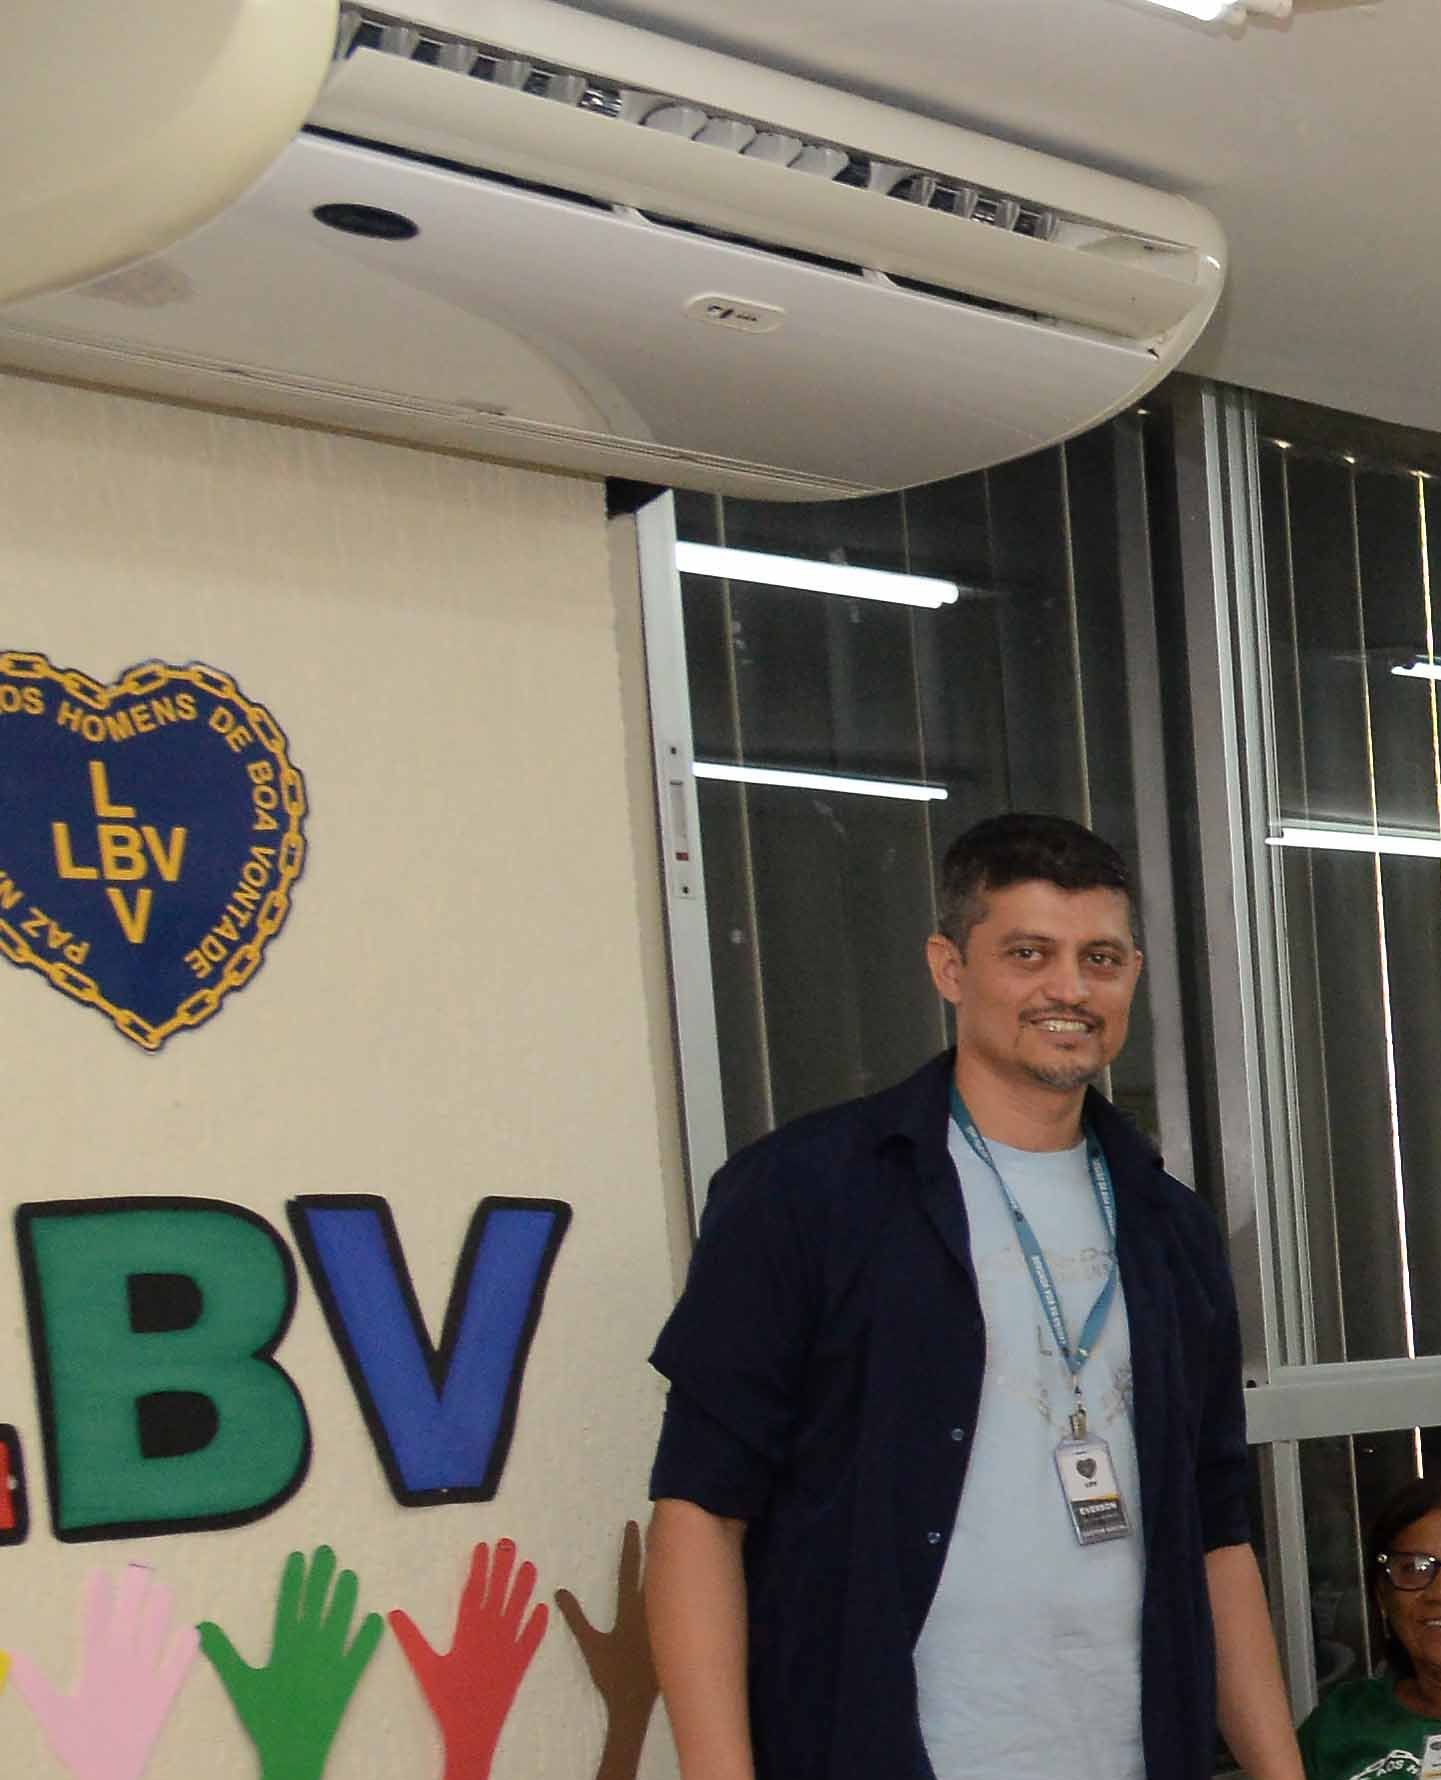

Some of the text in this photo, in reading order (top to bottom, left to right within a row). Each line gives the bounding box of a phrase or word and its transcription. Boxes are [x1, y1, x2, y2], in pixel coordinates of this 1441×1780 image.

[57, 692, 196, 742] HOMENS
[209, 706, 252, 752] DE
[88, 760, 135, 818] L
[246, 760, 279, 833] BOA
[52, 820, 187, 882] LBV
[21, 907, 91, 965] PAZ
[107, 888, 152, 944] V
[183, 845, 277, 979] VONTADE
[0, 1194, 572, 1546] BV
